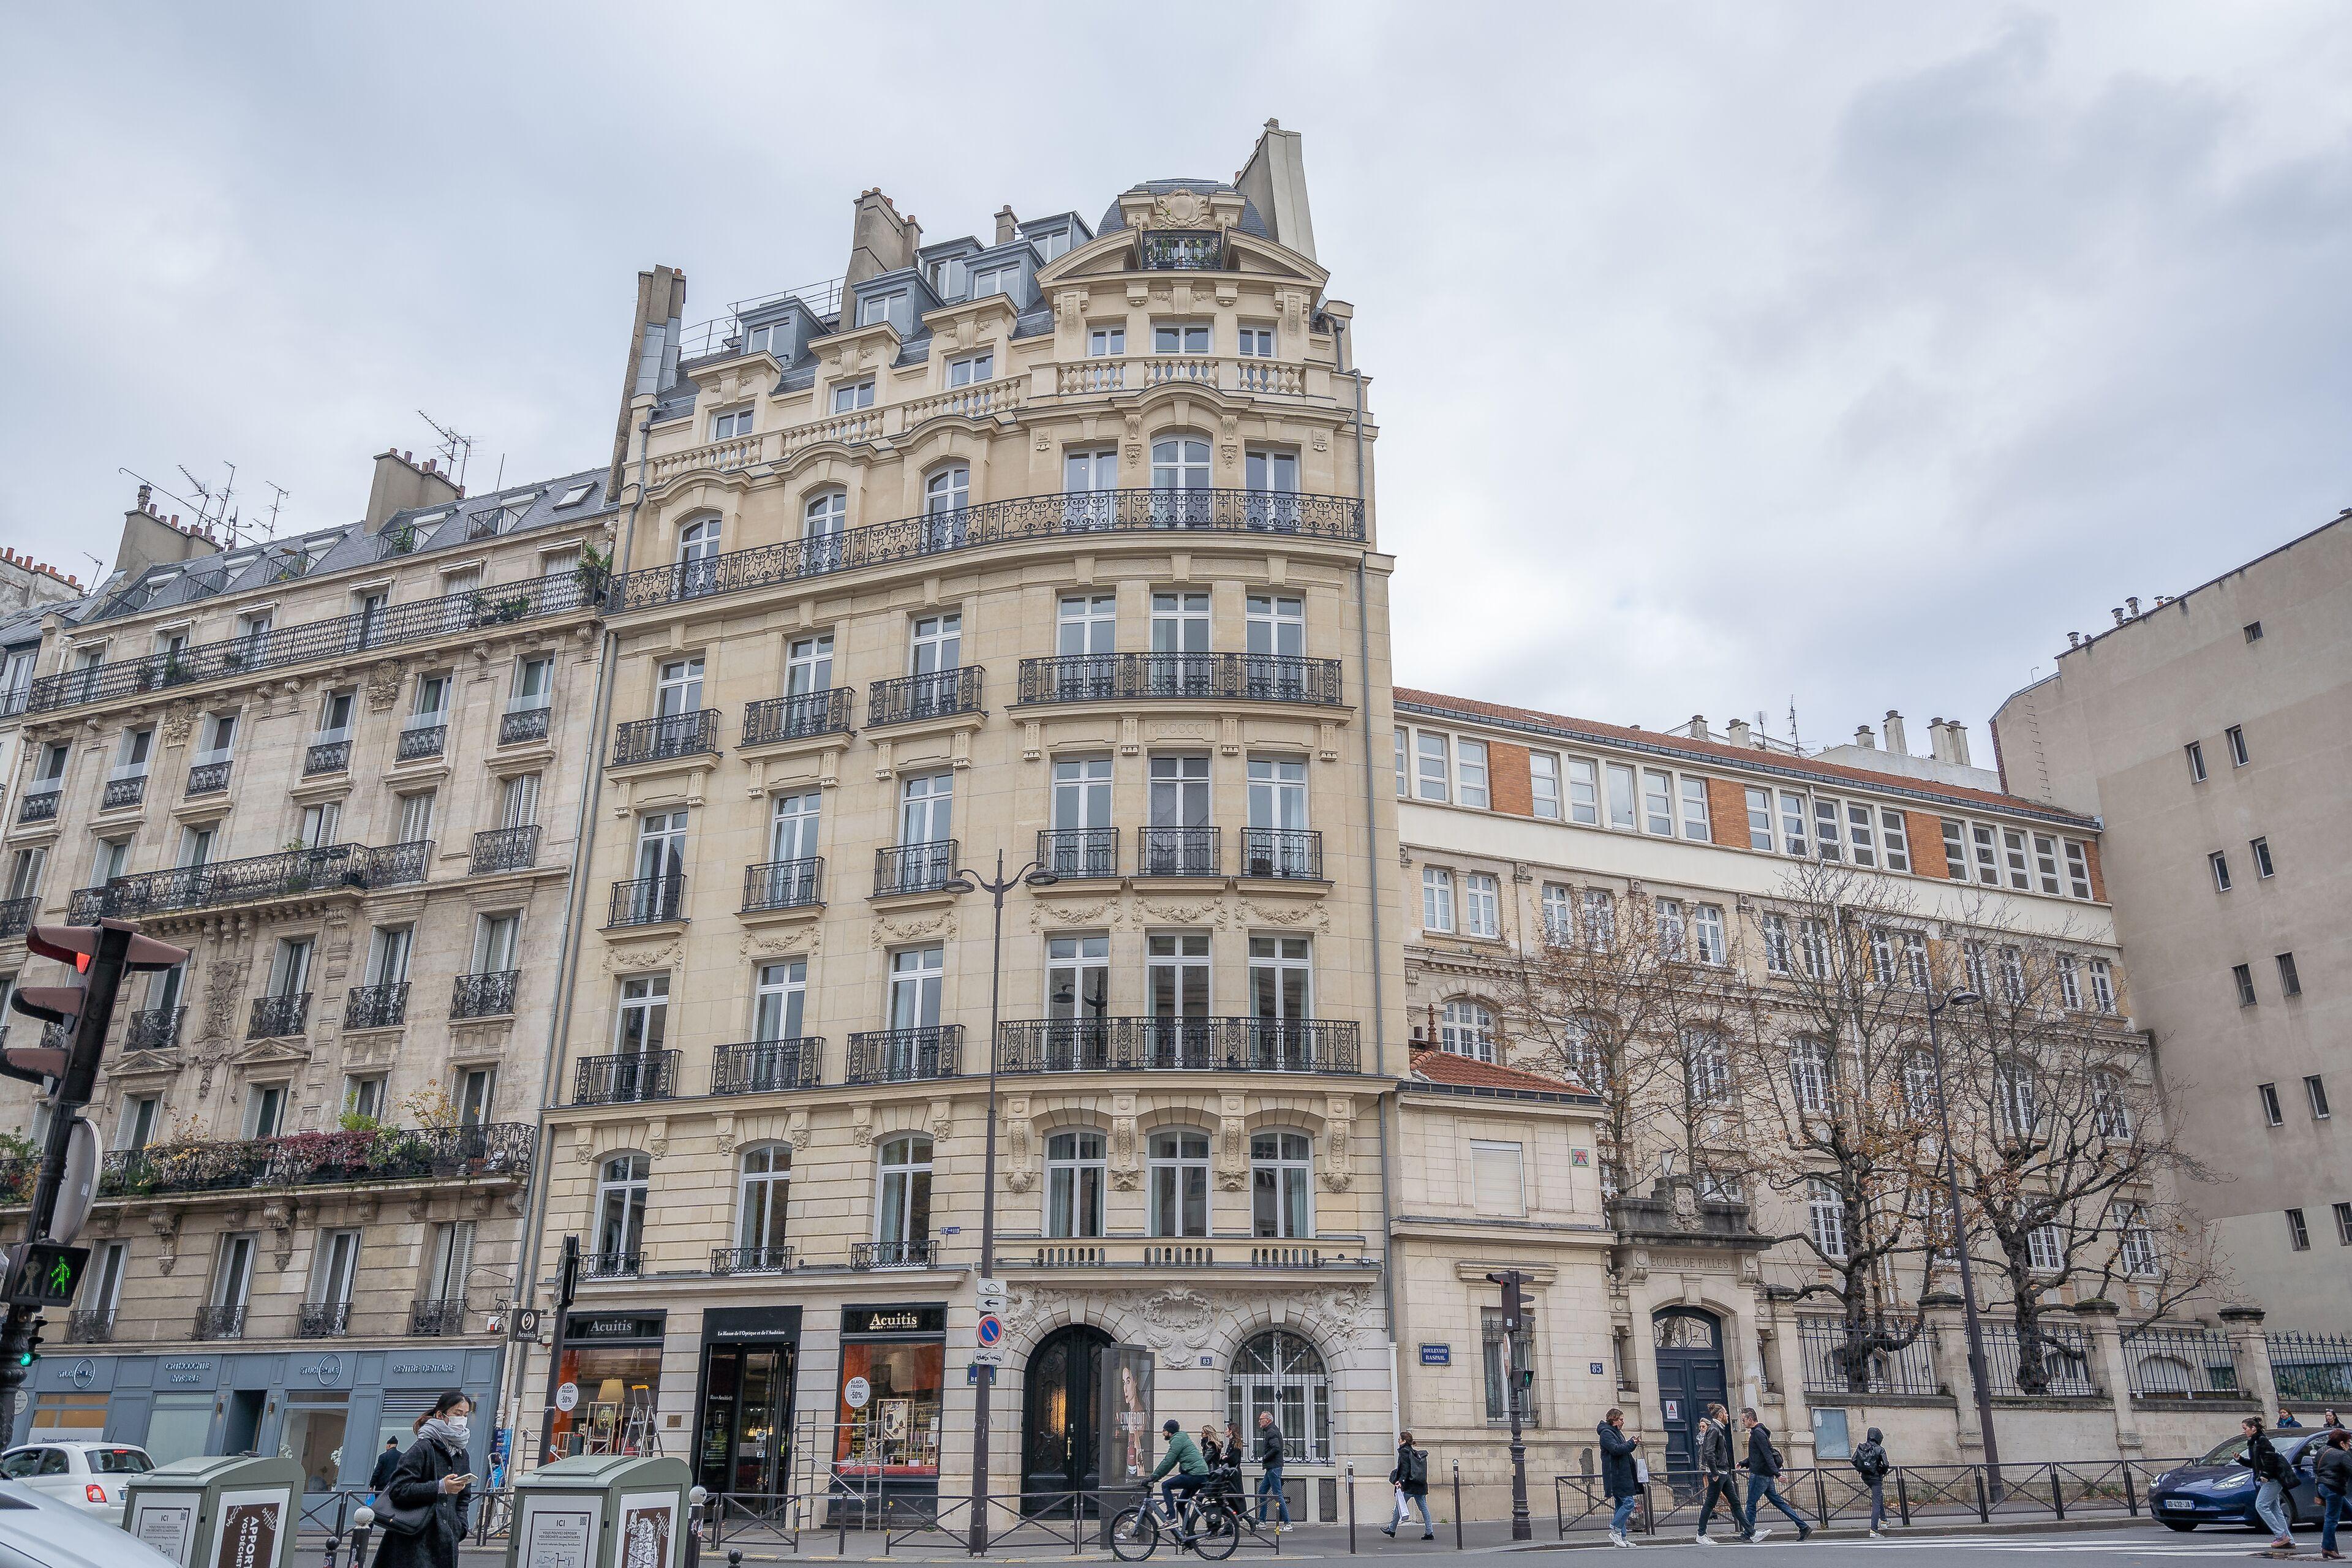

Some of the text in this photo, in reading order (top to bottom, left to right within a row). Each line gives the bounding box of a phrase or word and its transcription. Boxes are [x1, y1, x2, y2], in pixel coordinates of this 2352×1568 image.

[200, 1039, 225, 1053] 1880
[1684, 1257, 1695, 1267] DE
[1698, 1258, 1728, 1268] FILLES
[590, 1319, 631, 1331] Acuitis
[870, 1313, 917, 1325] Acuitis
[393, 1364, 456, 1373] CENTRE DENTAIRE
[1592, 1364, 1602, 1373] 85
[1120, 1411, 1145, 1424] L'INTERDIT
